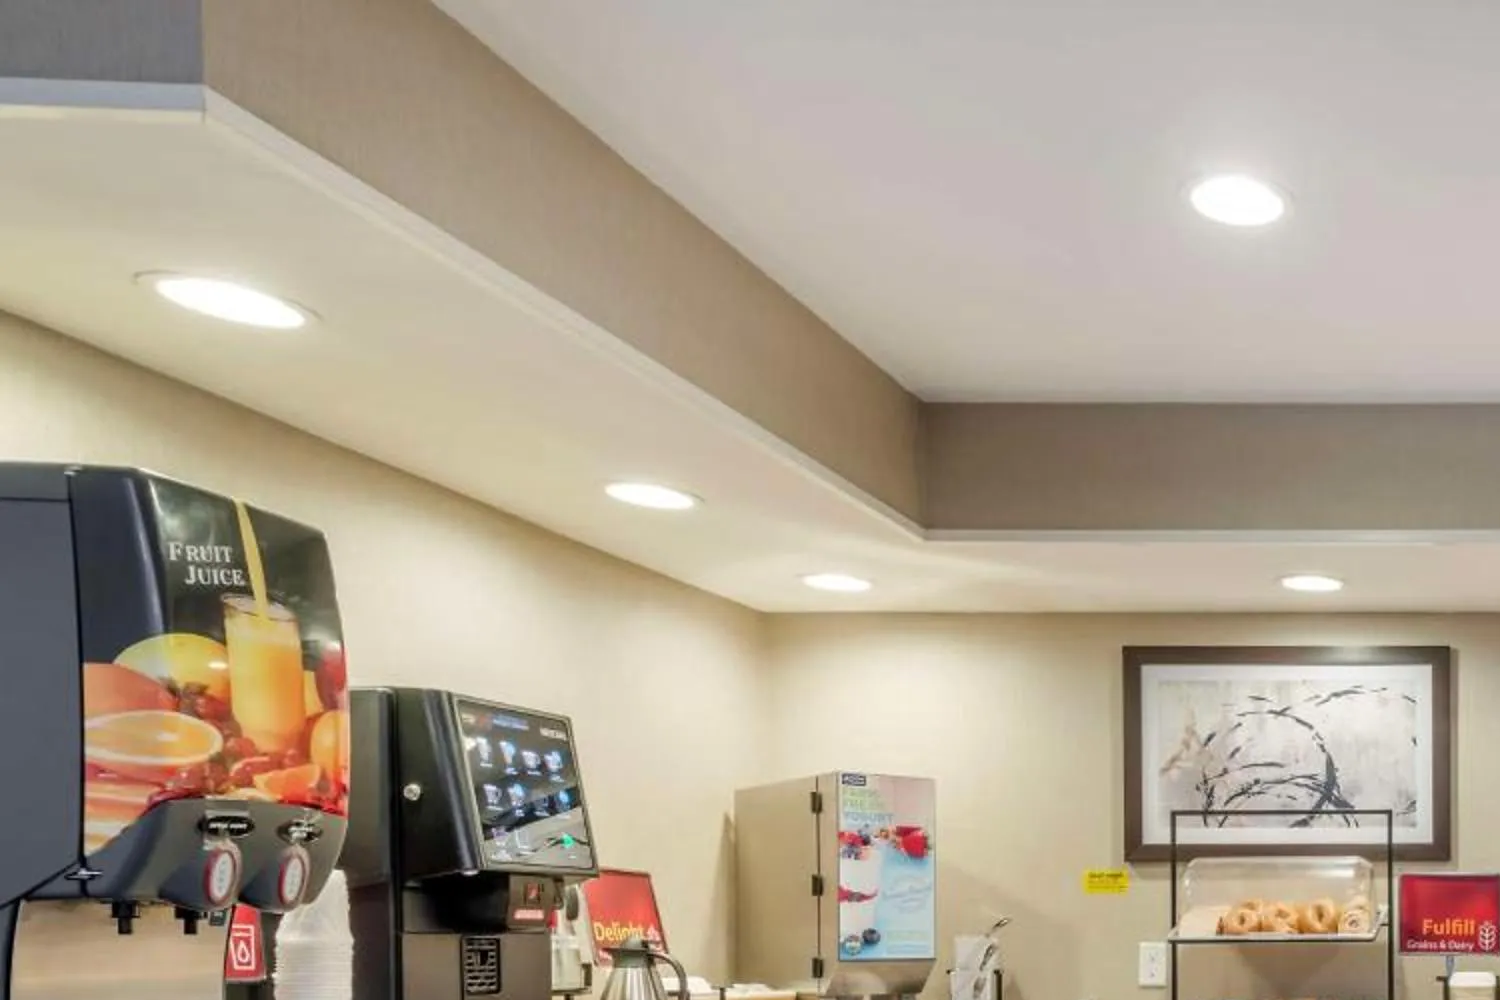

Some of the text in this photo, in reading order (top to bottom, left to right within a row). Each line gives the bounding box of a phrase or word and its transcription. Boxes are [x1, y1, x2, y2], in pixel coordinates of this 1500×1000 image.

[168, 542, 232, 563] FRUIT
[185, 565, 246, 586] JUICE
[1423, 918, 1476, 936] Fulfill
[1439, 939, 1447, 949] &
